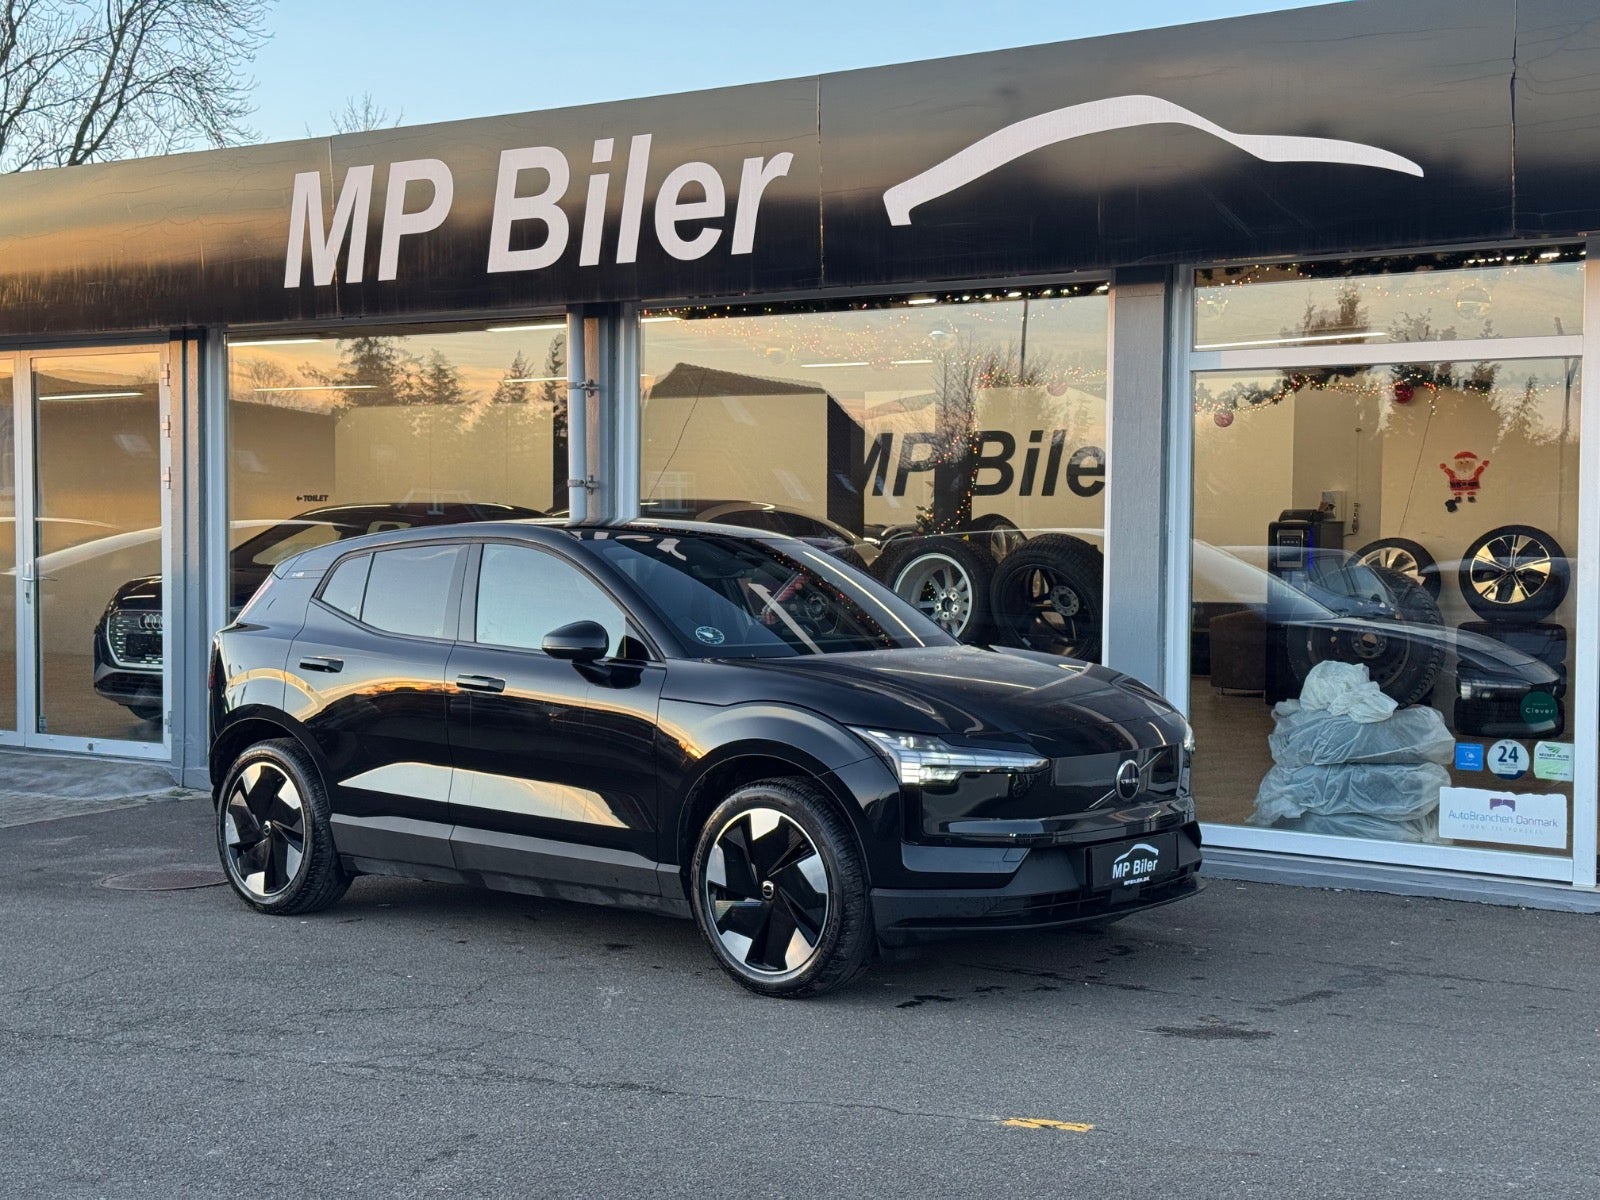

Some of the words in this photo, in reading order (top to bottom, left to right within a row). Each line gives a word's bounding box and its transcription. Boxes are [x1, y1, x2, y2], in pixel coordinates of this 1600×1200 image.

[284, 158, 454, 288] MP
[486, 133, 794, 273] Biler
[969, 430, 1106, 497] Bile
[303, 494, 329, 502] TOILET
[1497, 745, 1519, 763] 24
[1448, 809, 1514, 824] AutoBranchen
[1515, 814, 1559, 828] Danmark
[1112, 862, 1130, 879] MP
[1133, 858, 1158, 875] Biler
